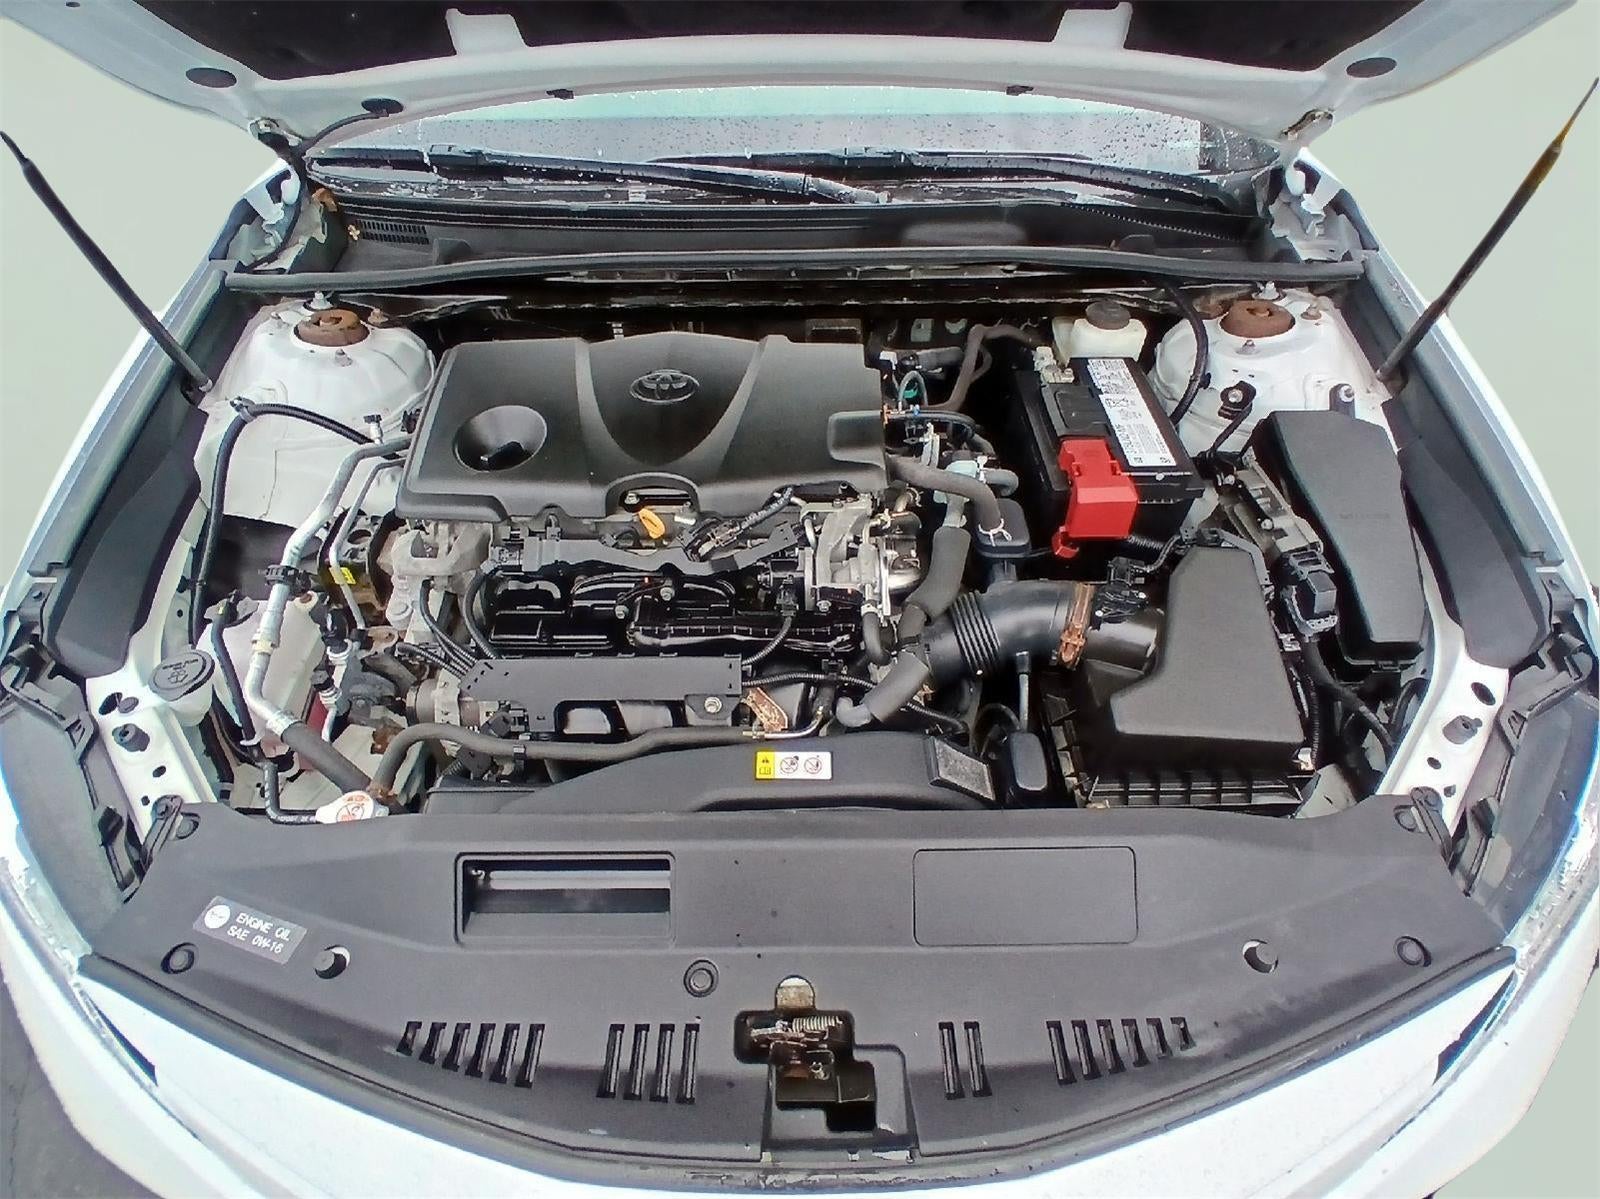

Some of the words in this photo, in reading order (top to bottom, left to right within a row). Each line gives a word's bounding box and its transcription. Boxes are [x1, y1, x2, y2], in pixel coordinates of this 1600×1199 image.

[227, 925, 250, 941] SAE
[252, 934, 284, 953] 0W-16
[236, 912, 273, 934] ENGINE
[274, 927, 292, 941] OIL
